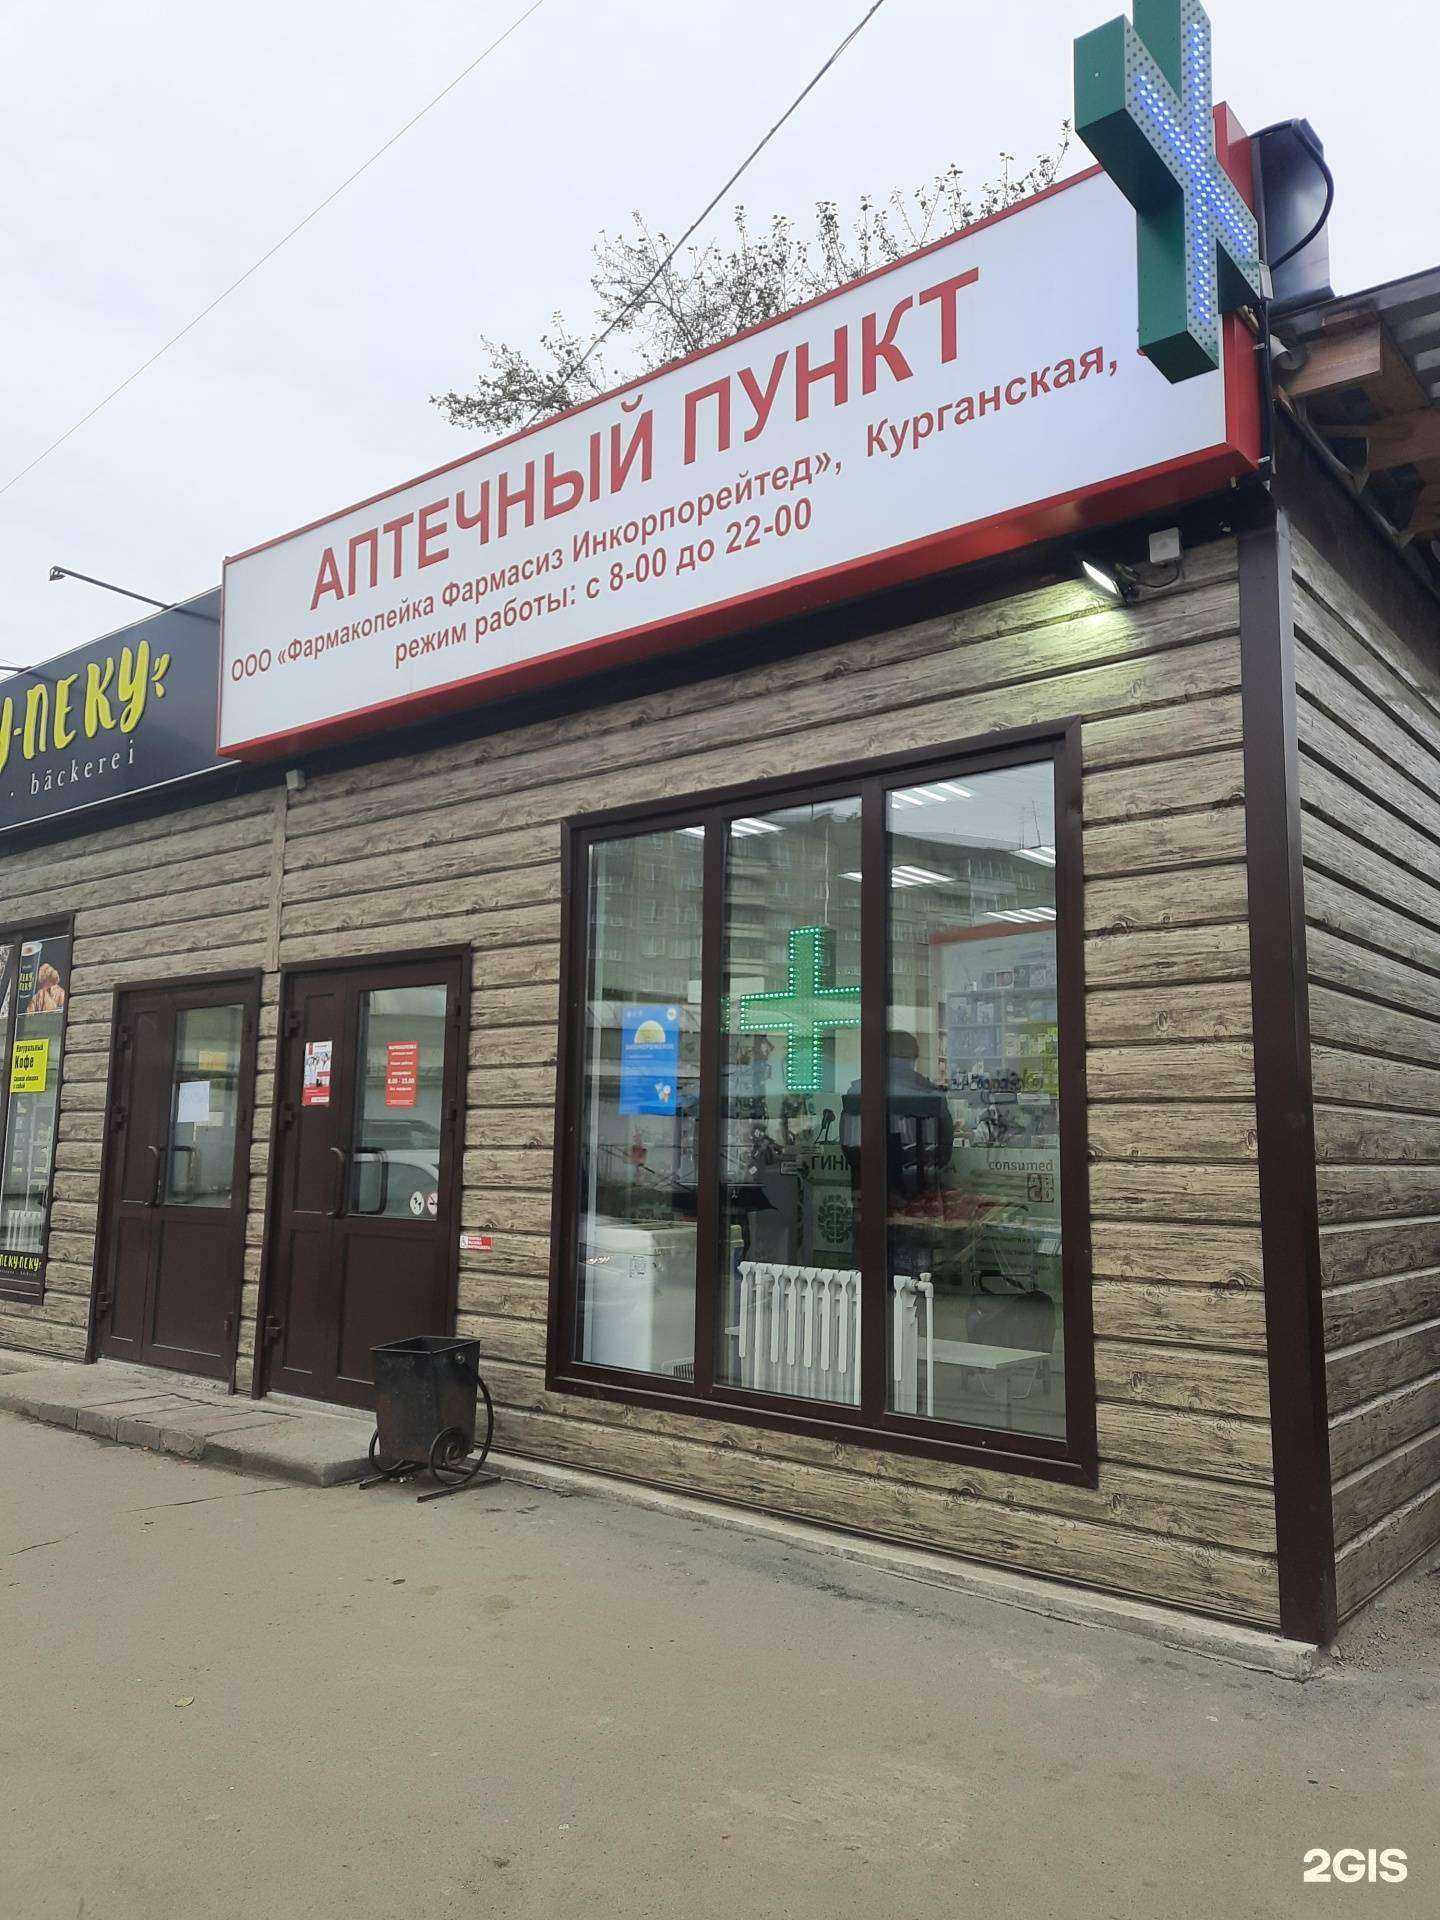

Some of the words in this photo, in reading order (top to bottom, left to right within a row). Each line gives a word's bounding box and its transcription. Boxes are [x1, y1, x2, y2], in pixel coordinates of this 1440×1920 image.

[231, 649, 272, 681] ООО
[277, 590, 434, 665] «Фармакопейка
[441, 539, 563, 608] Фармасиз
[572, 451, 842, 563] Инкорпорейтед»,
[866, 345, 1118, 458] Курганская,
[310, 394, 653, 610] АПТЕЧНЫЙ
[683, 266, 979, 465] ПУНКТ
[395, 625, 467, 668] режим
[474, 586, 575, 645] работы:
[585, 576, 601, 600] с
[609, 546, 667, 593] 8-00
[676, 534, 715, 577] до
[725, 497, 812, 555] 22-00
[14, 1055, 34, 1071] Кофе
[989, 1160, 1053, 1171] consumed
